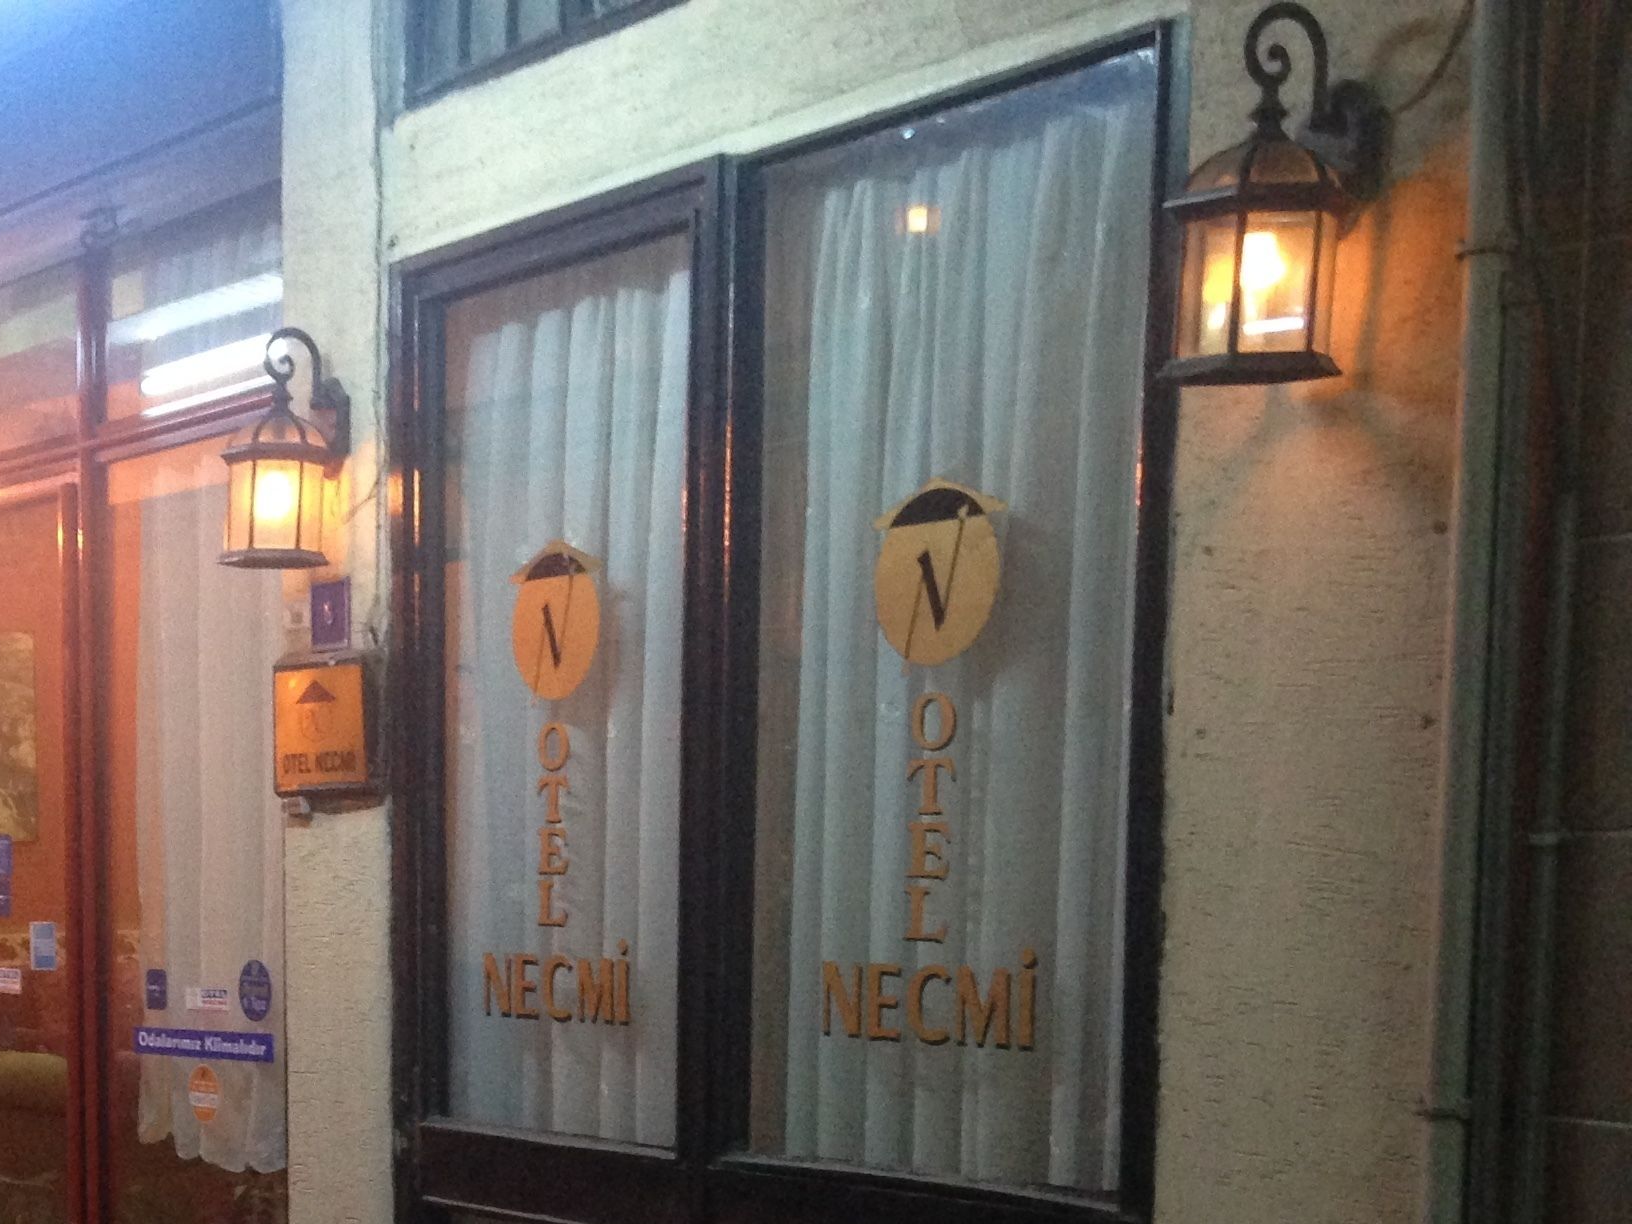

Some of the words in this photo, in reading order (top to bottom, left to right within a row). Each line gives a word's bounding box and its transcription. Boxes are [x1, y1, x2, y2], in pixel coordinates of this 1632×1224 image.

[536, 721, 569, 928] OTEL
[903, 692, 958, 944] OTEL
[481, 938, 632, 1026] NECMİ
[821, 947, 1040, 1052] NECMİ
